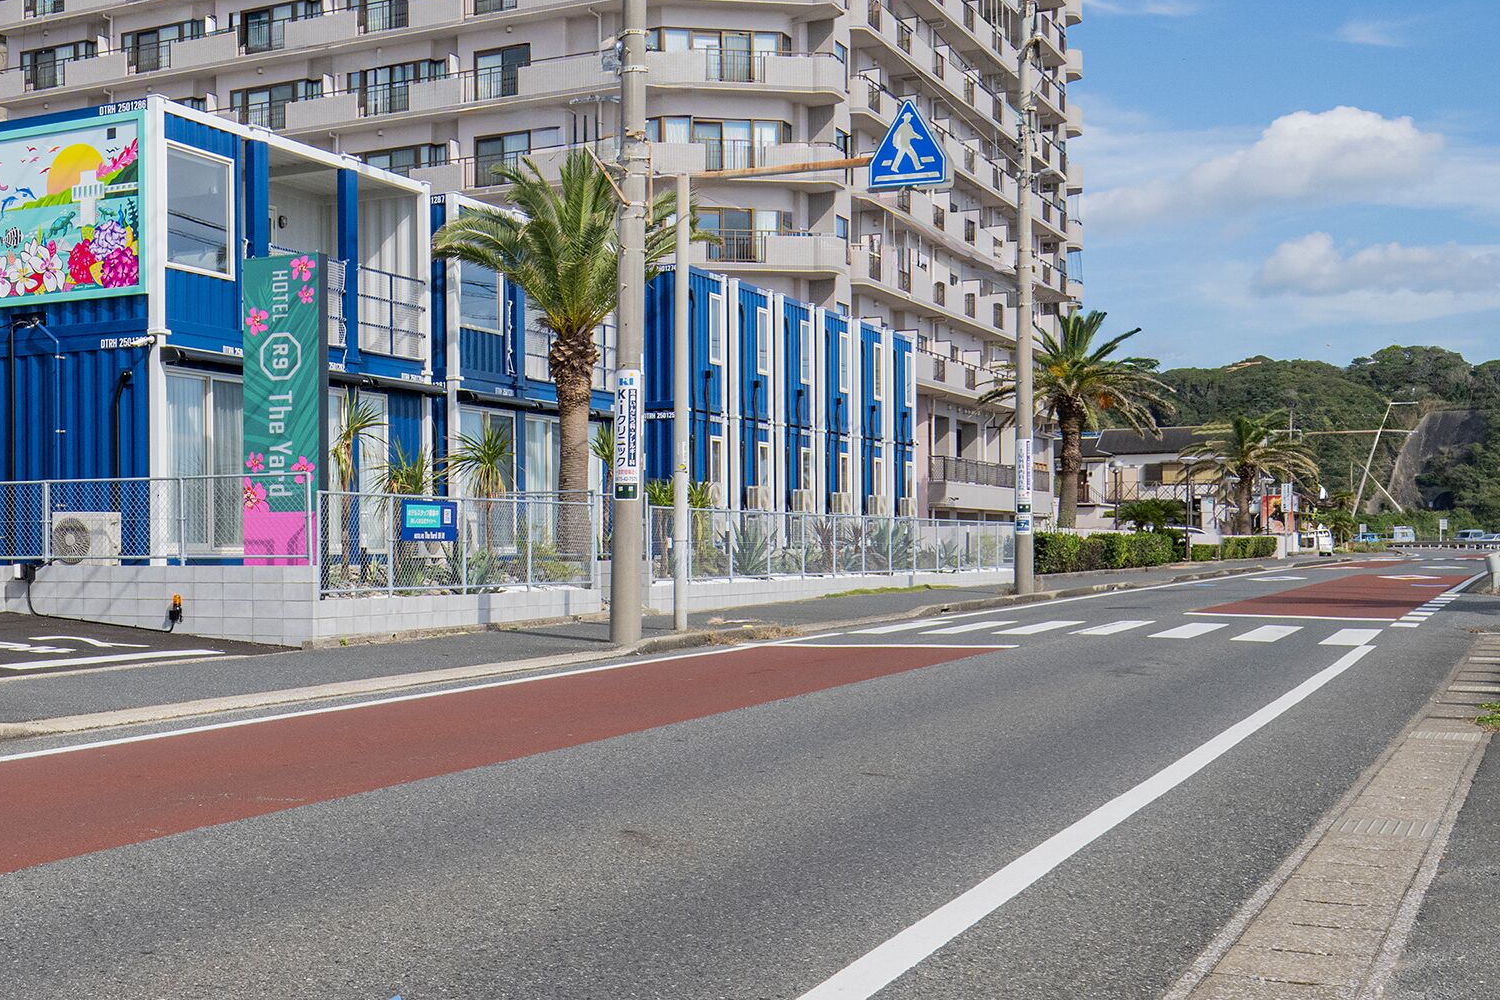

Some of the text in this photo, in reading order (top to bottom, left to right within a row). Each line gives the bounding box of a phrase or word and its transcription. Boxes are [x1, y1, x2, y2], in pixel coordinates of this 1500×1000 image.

[268, 270, 293, 497] HOTEL R9 The Yard
